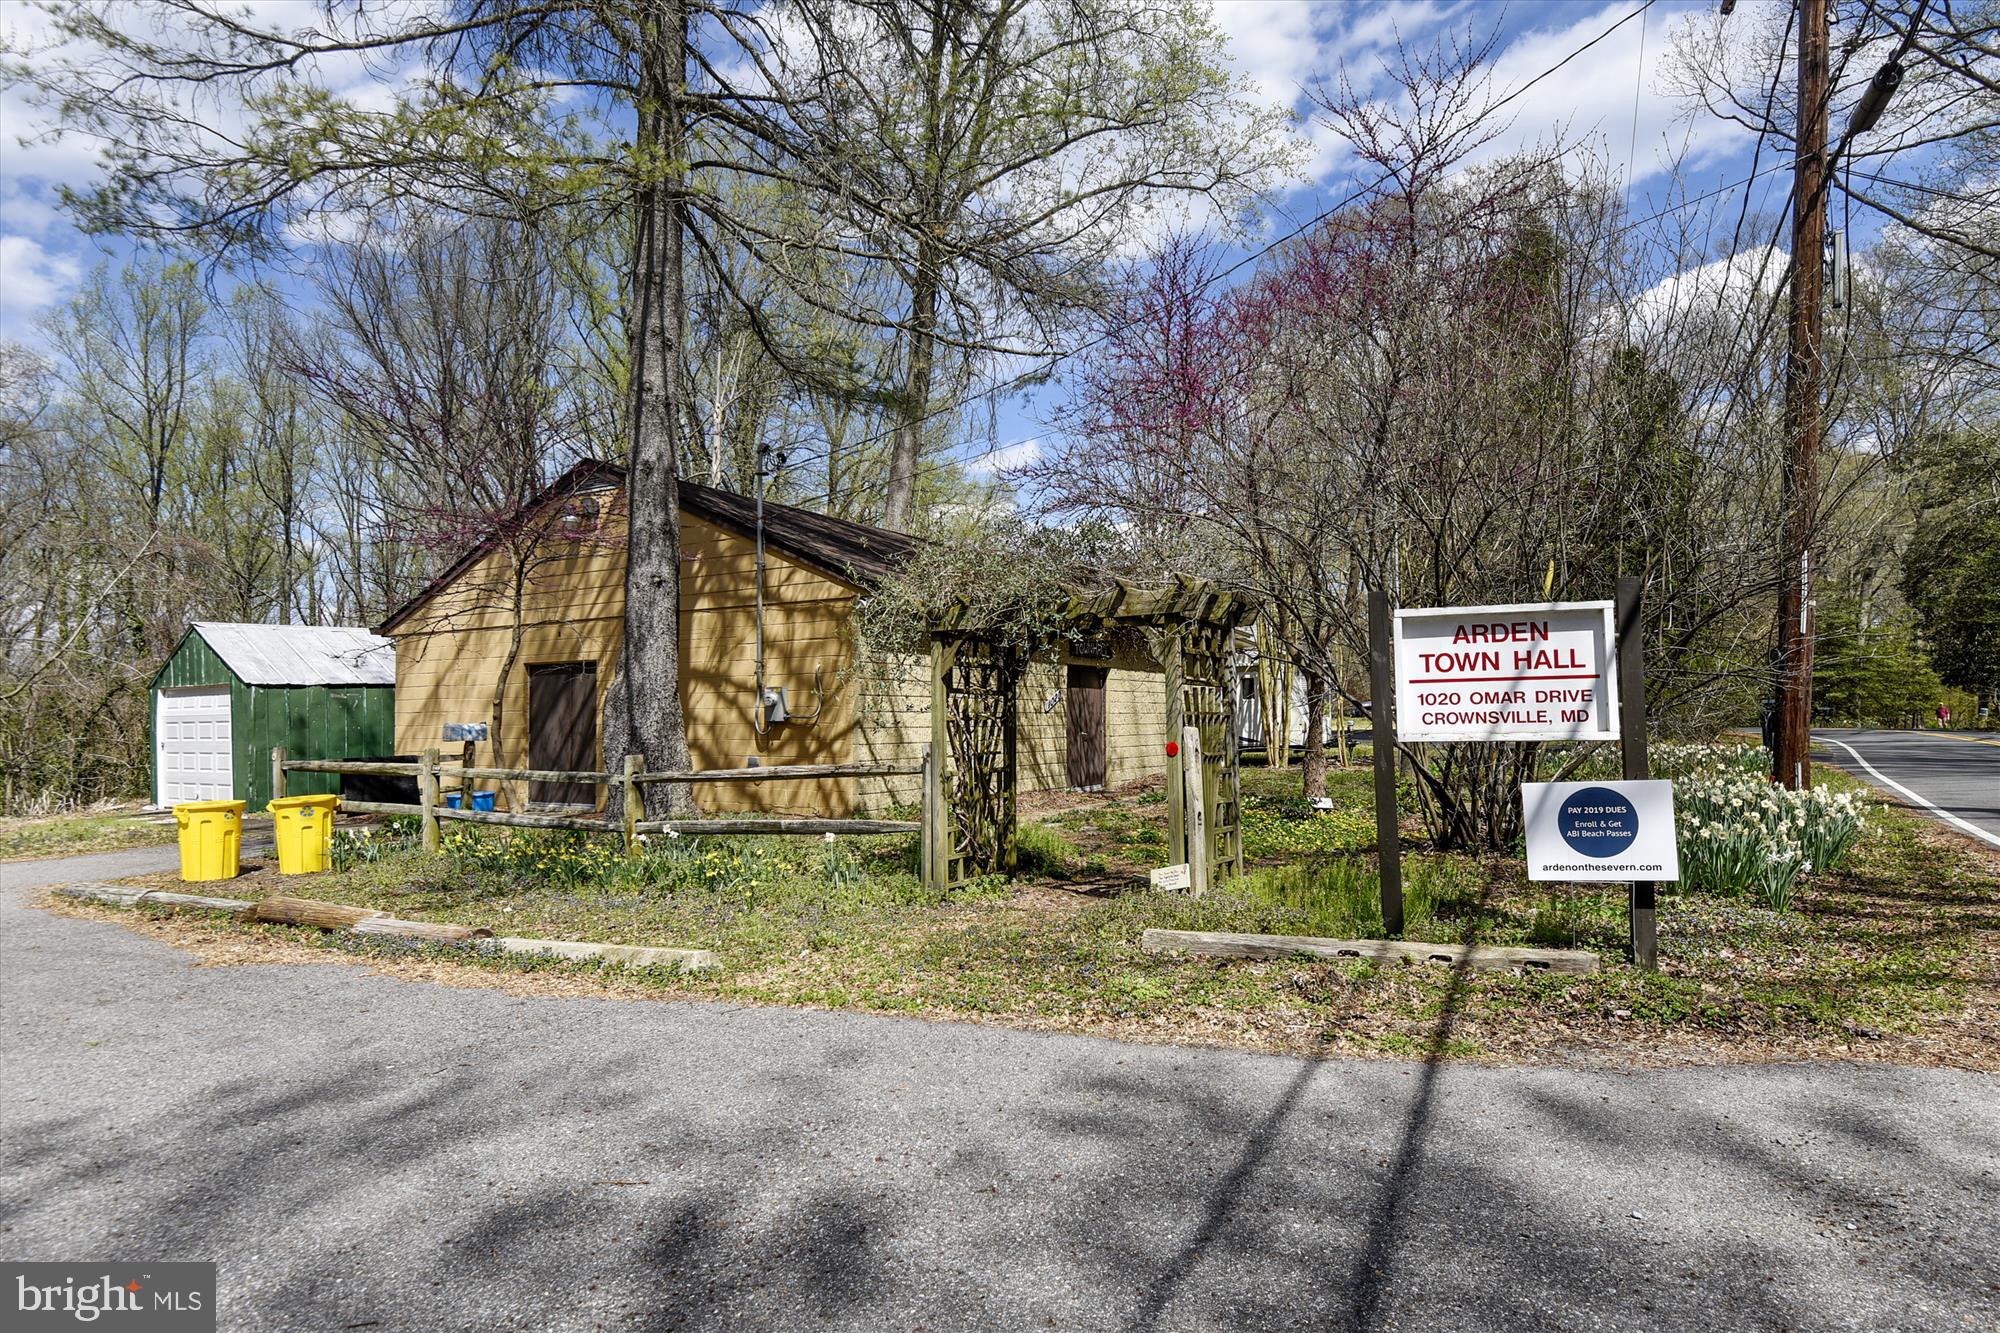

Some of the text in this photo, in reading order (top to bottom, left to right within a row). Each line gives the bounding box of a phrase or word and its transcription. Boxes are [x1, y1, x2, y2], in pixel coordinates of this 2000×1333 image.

[1453, 621, 1549, 645] ARDEN
[1419, 649, 1586, 673] TOWN HALL
[1417, 689, 1593, 706] 1020 OMAR DRIVE
[1422, 709, 1590, 726] CROWNSVILLE, MD
[1567, 805, 1627, 814] PAY 2019 DUES
[1574, 820, 1622, 828] Enroll & Get
[1566, 829, 1632, 838] ABI Beach Passes
[1542, 863, 1663, 872] ardenonthesevern.com
